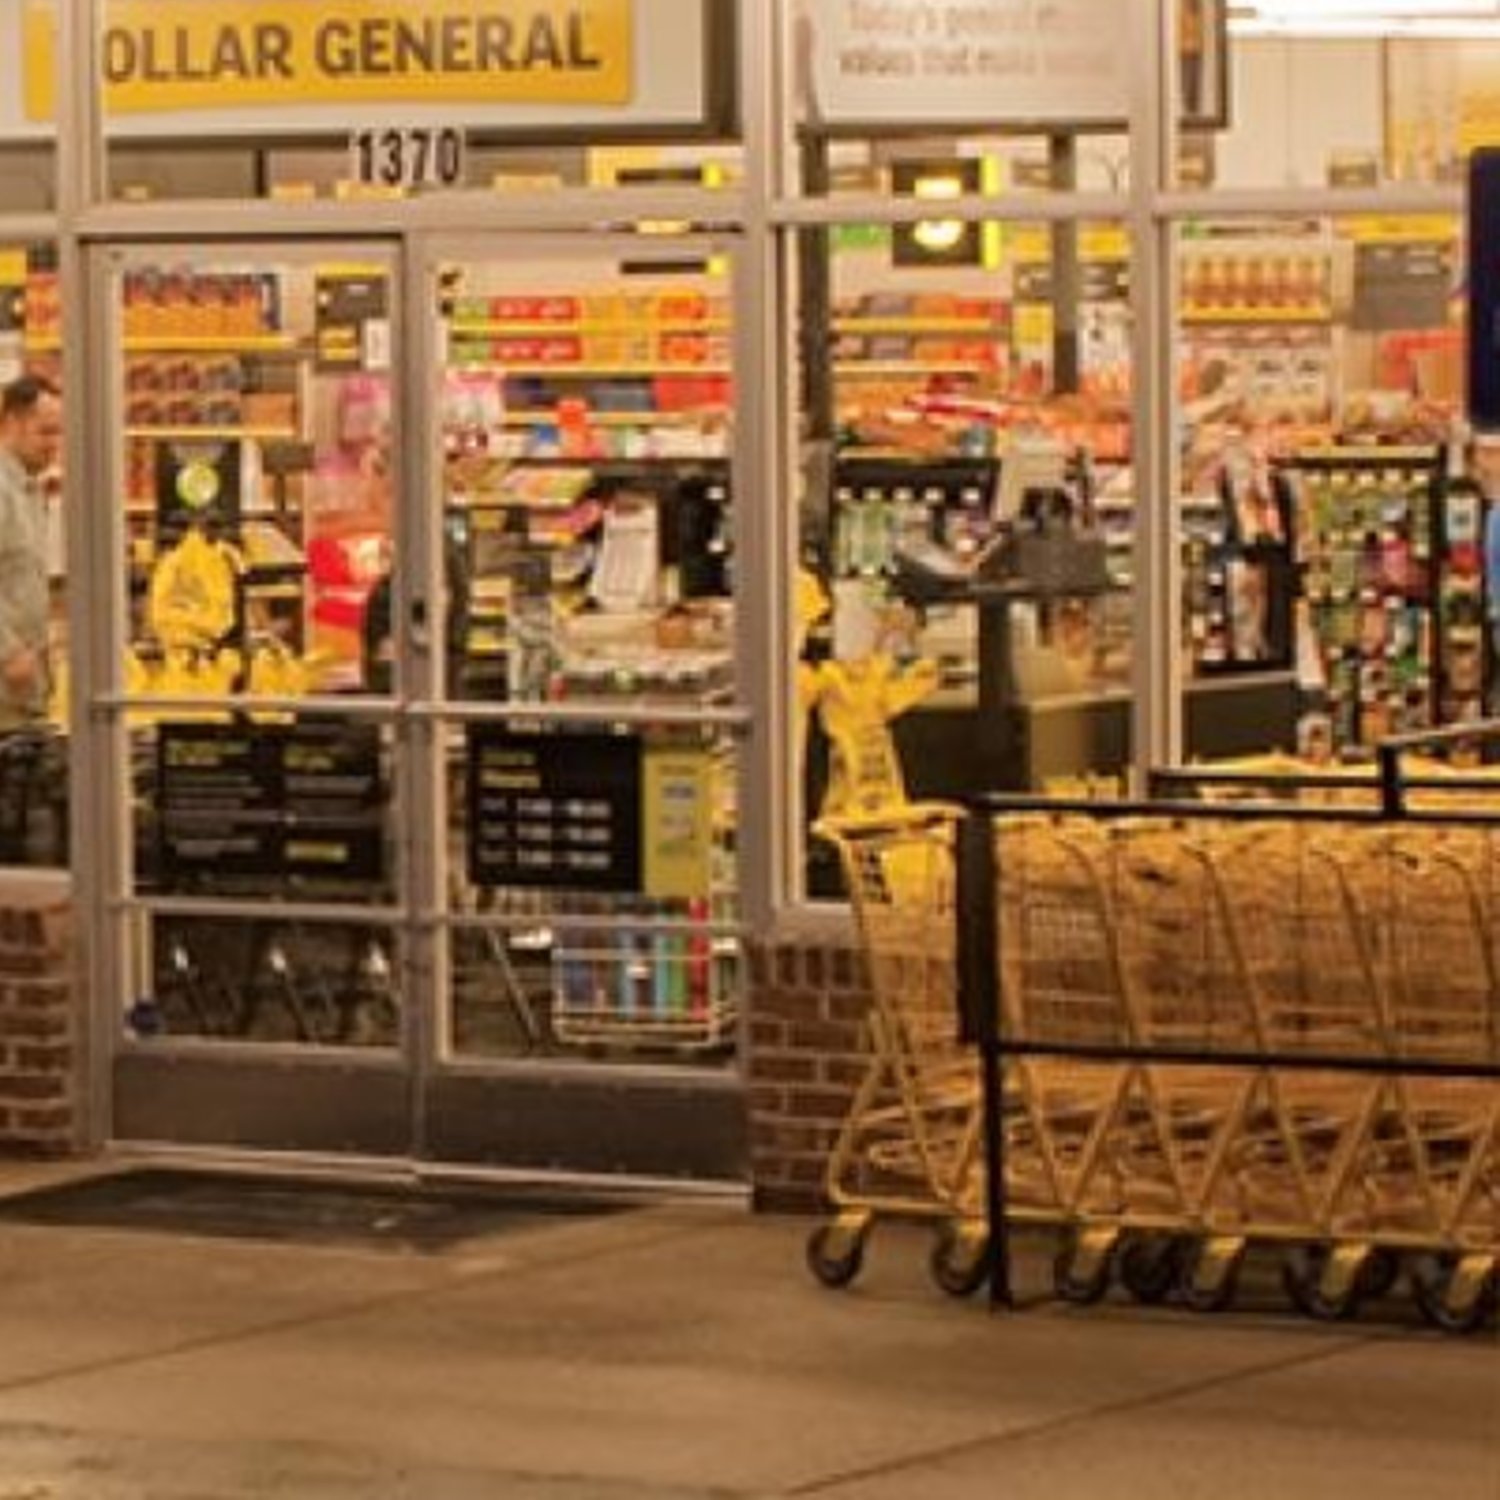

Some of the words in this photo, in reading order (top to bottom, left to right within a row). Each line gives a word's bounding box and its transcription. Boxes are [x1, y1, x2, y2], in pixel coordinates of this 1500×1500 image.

[103, 23, 293, 82] OLLAR
[313, 10, 600, 77] GENERAL
[354, 128, 461, 183] 1370
